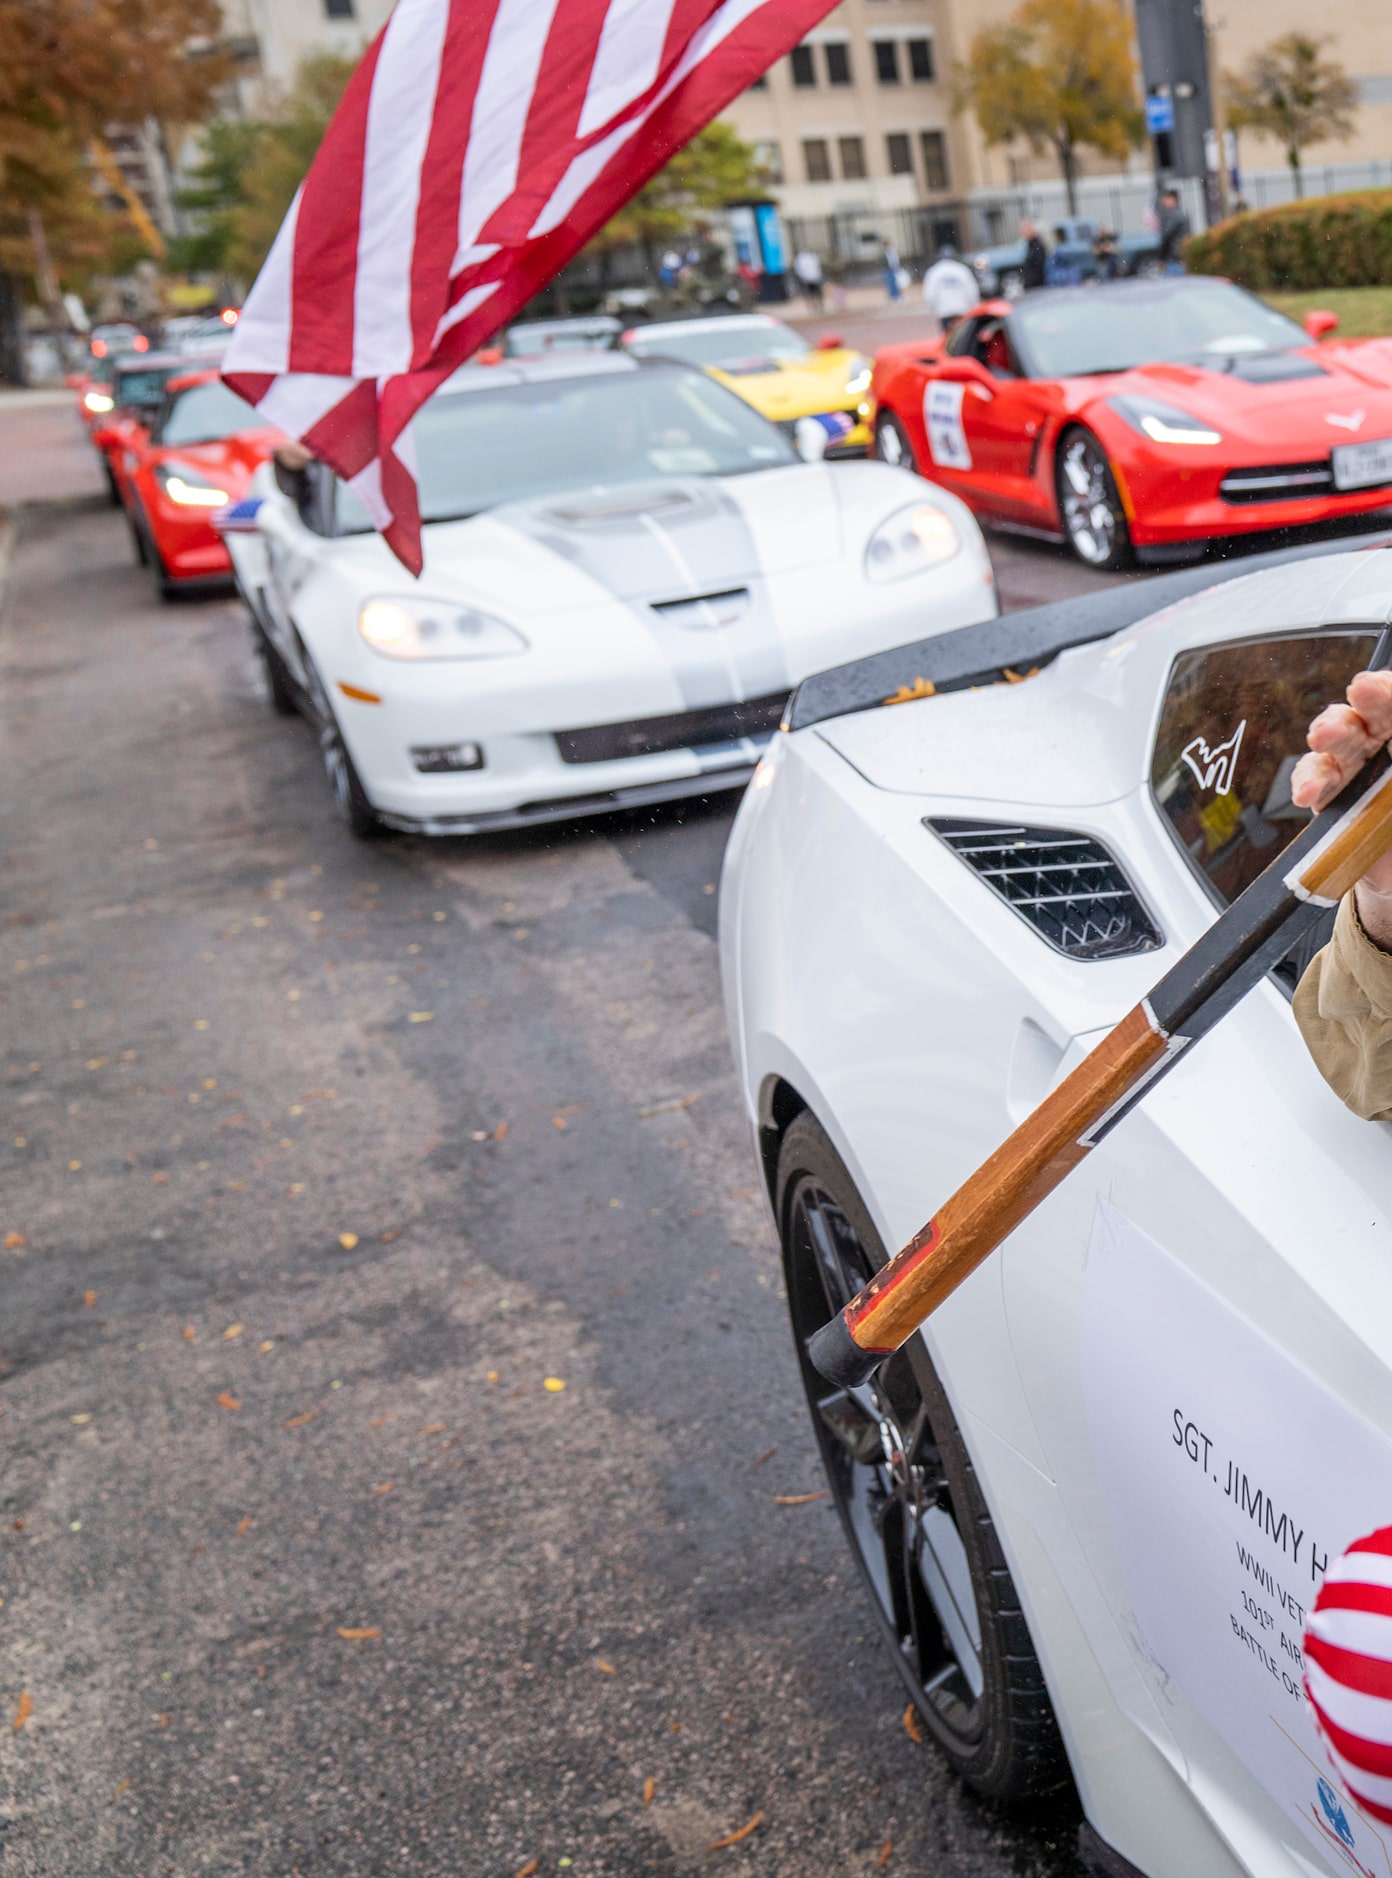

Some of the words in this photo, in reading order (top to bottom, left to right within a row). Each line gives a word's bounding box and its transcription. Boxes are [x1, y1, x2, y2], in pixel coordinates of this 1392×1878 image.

[1173, 1408, 1217, 1483] SGT.
[1224, 1461, 1304, 1564] JIMMY
[1312, 1542, 1328, 1582] H
[1236, 1541, 1274, 1597] WWII
[1277, 1583, 1306, 1626] VET
[1231, 1614, 1280, 1681] BATTLE
[1282, 1672, 1299, 1701] OF
[1281, 1632, 1305, 1670] AIR
